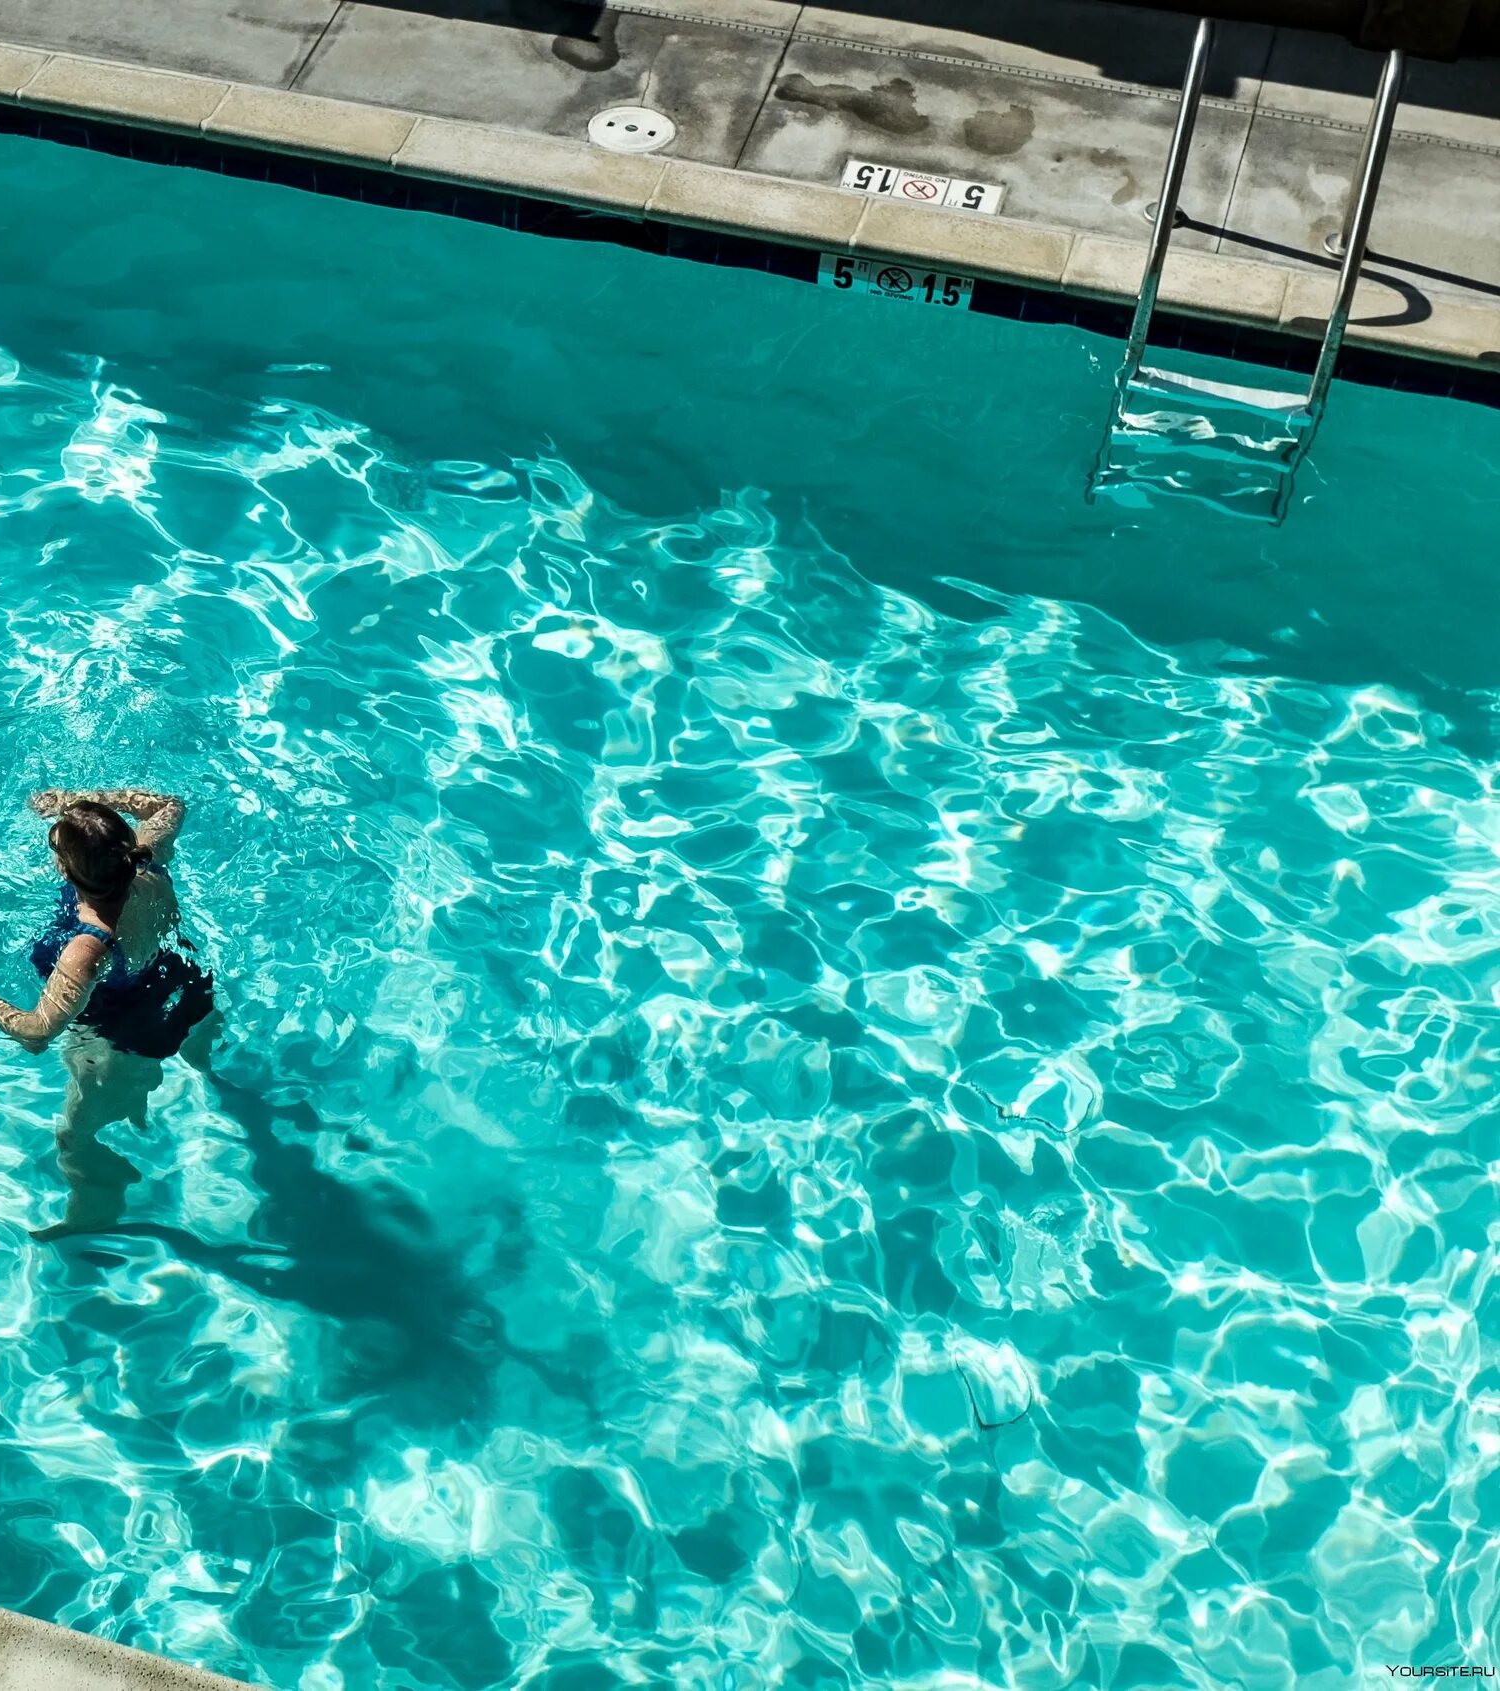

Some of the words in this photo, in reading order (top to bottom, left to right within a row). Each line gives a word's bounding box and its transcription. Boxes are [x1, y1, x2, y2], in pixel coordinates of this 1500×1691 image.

[853, 165, 892, 193] 1.5
[903, 171, 933, 181] DIVING
[961, 185, 986, 210] 5
[833, 256, 856, 289] 5
[858, 261, 869, 273] FT
[922, 273, 962, 306] 1.5
[963, 279, 973, 289] M
